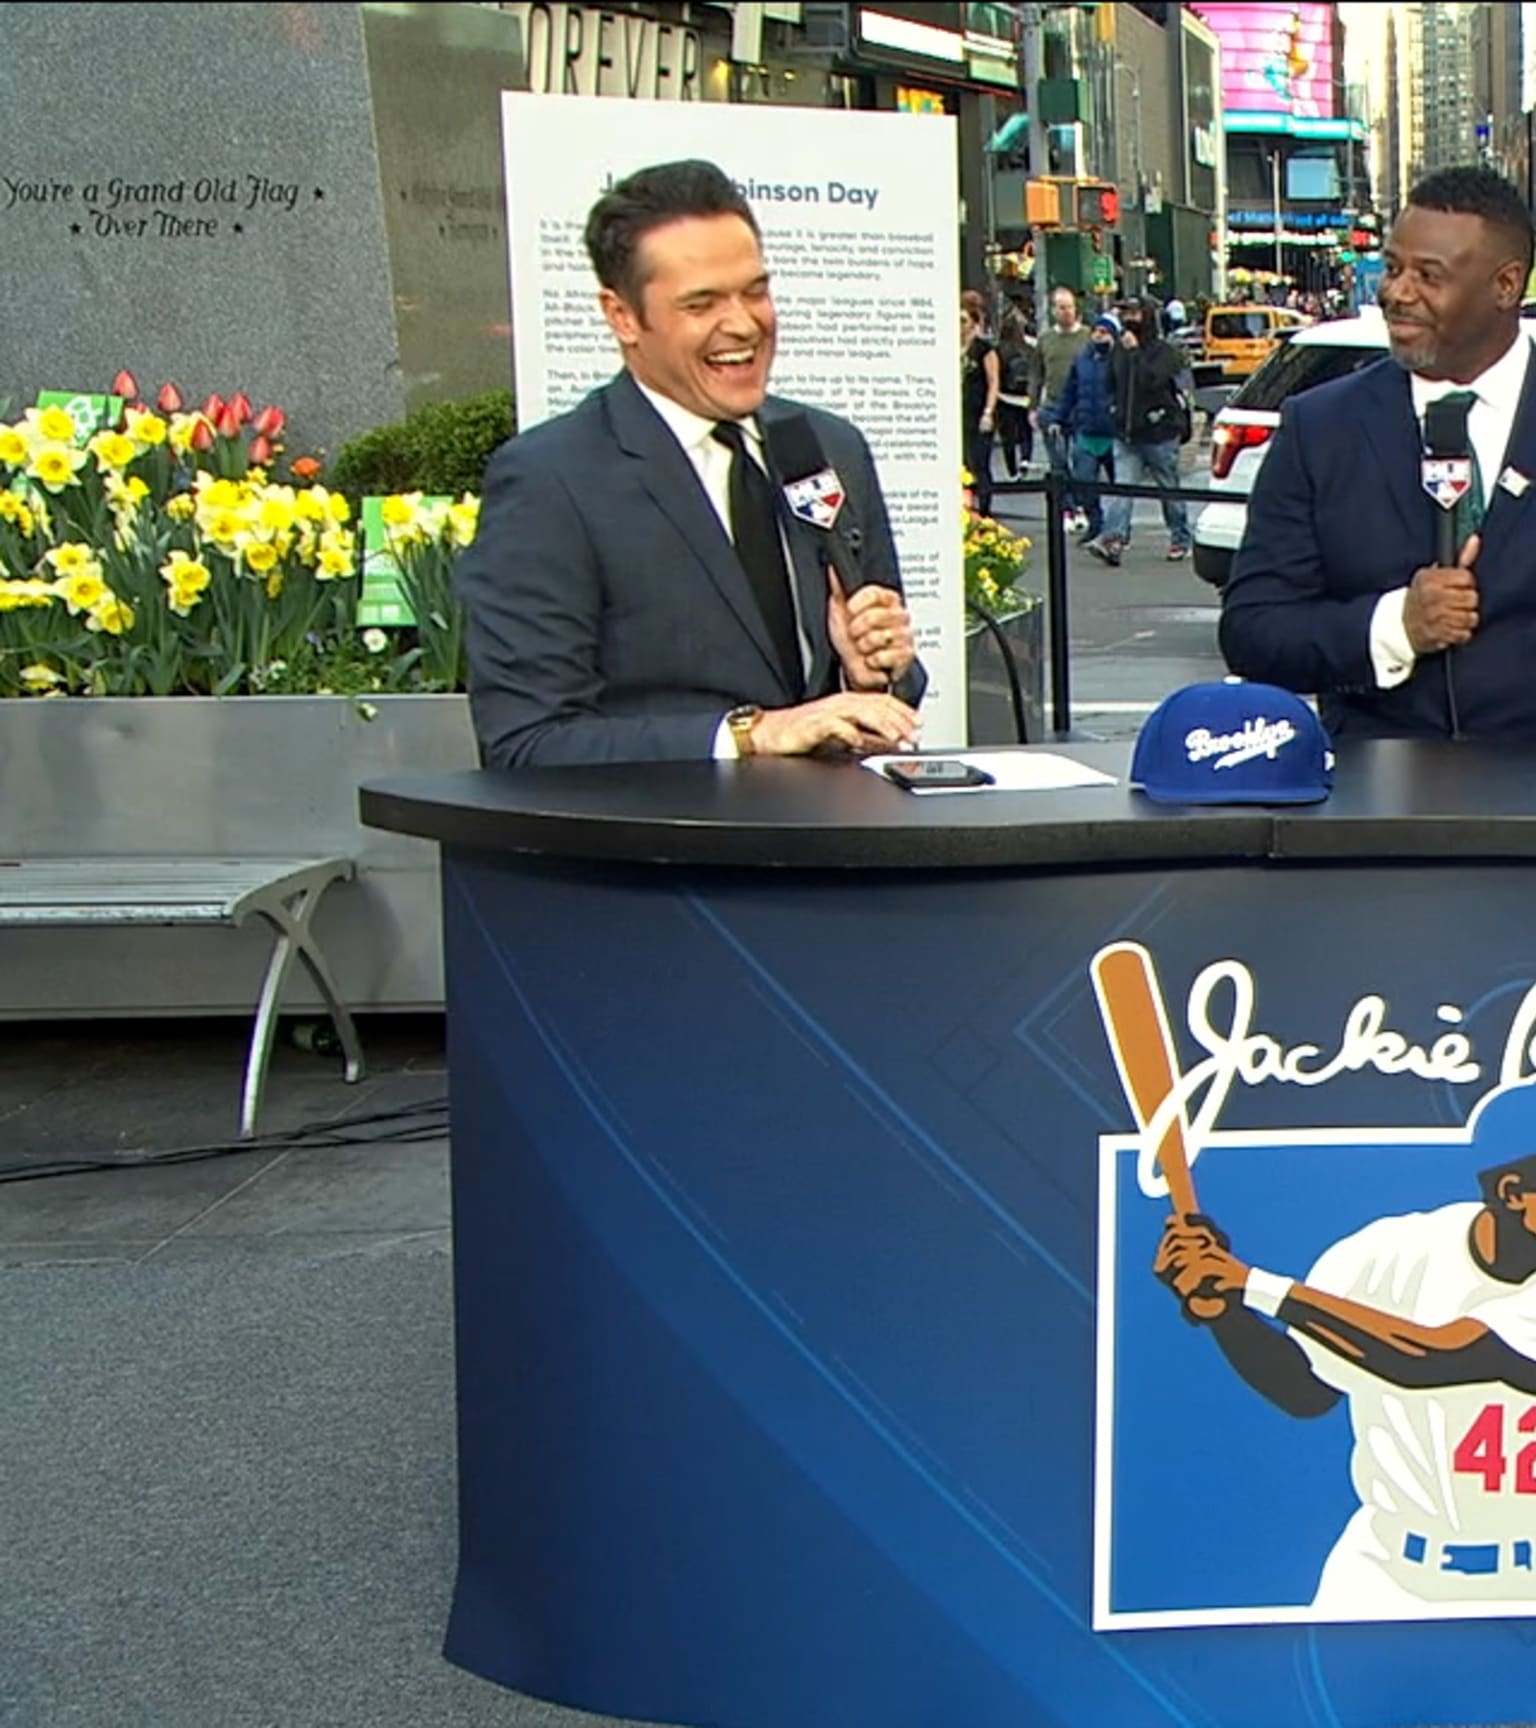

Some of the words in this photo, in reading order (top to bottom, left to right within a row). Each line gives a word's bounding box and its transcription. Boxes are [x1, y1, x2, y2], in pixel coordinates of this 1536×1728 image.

[527, 4, 703, 102] OREVER
[3, 176, 73, 210] You're
[83, 184, 98, 202] a
[106, 177, 184, 209] Grand
[194, 178, 236, 202] Old
[245, 174, 299, 211] Flag
[731, 177, 819, 203] binson
[828, 181, 879, 211] Day
[89, 209, 147, 237] Over
[153, 210, 218, 237] There
[1185, 716, 1296, 771] Brooklyn
[1140, 958, 1481, 1198] Jackie
